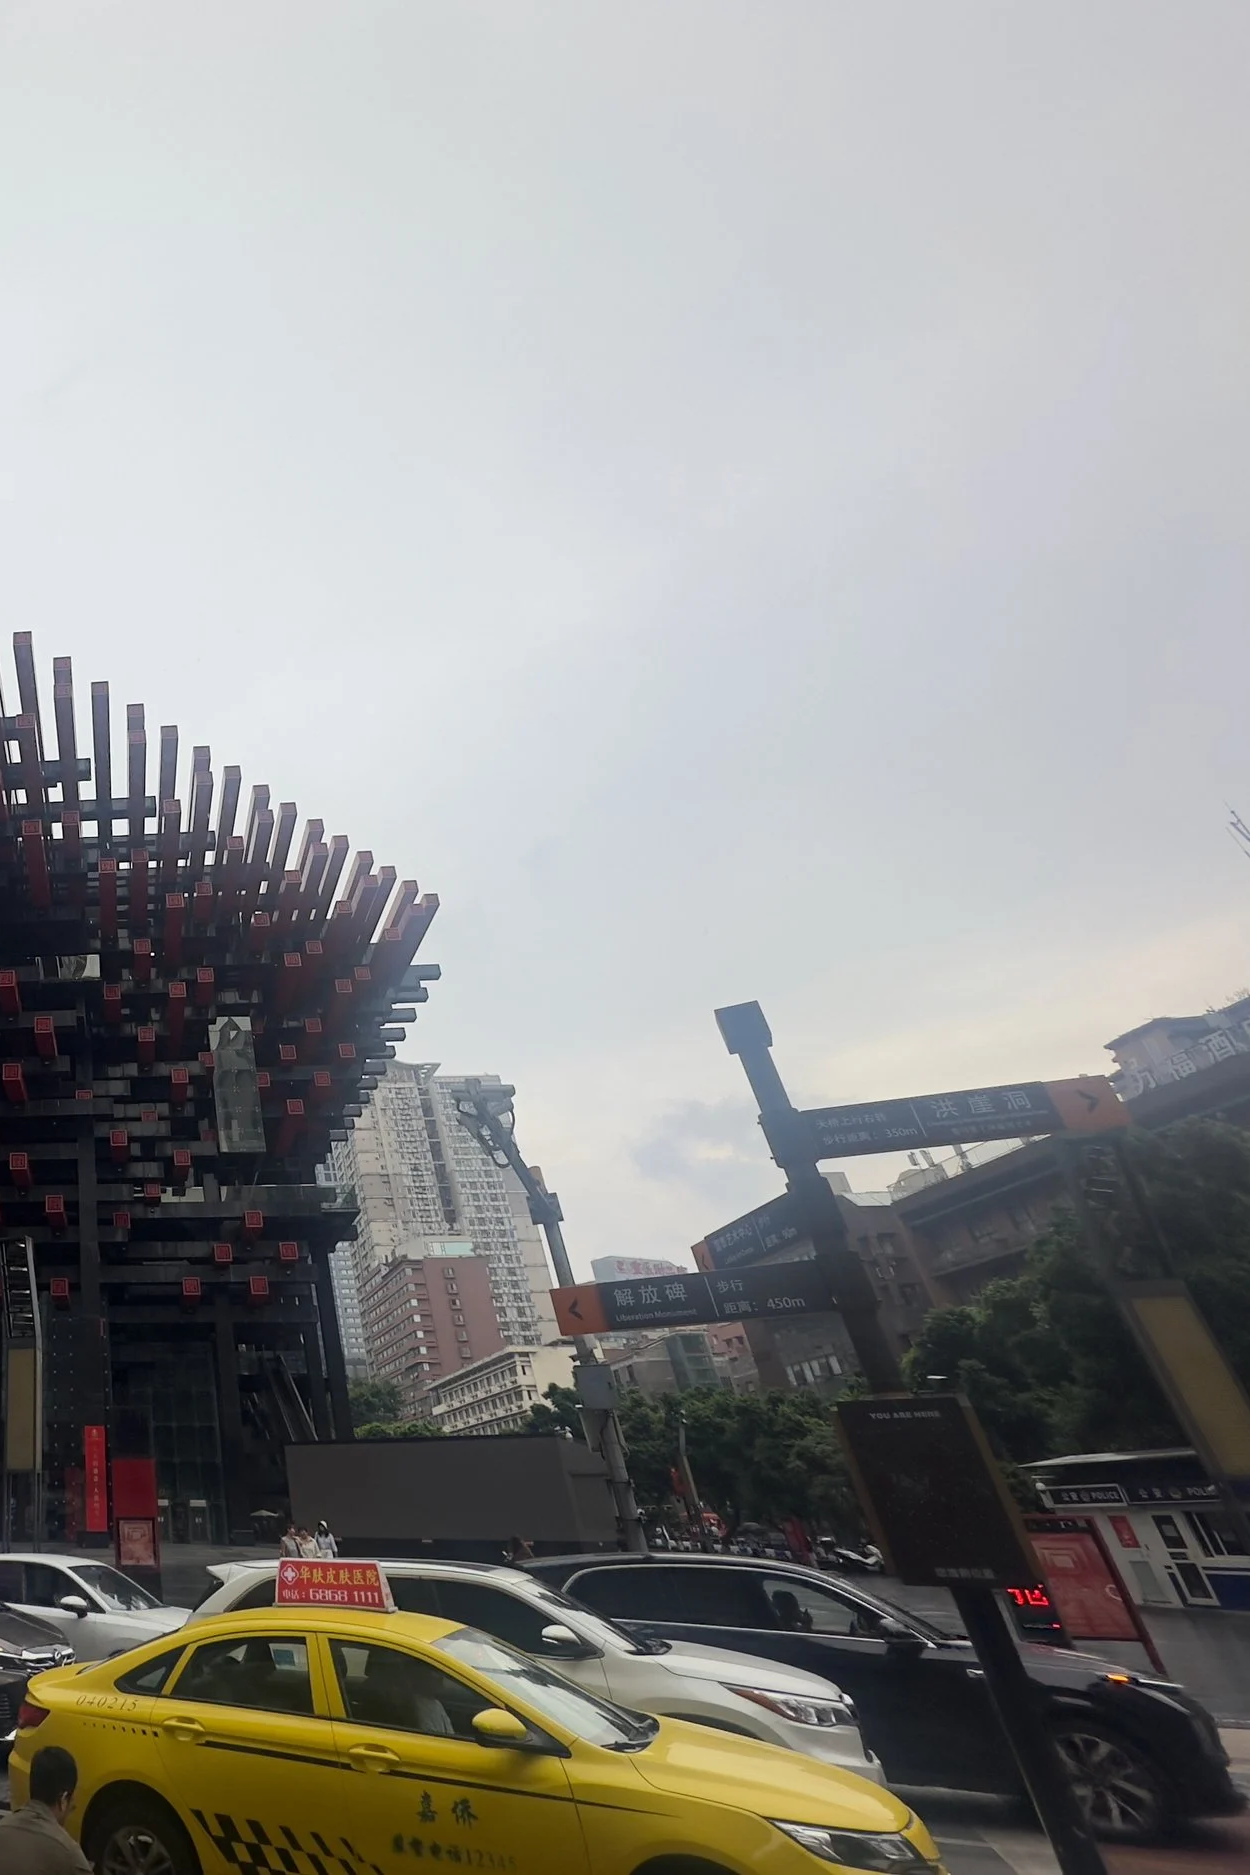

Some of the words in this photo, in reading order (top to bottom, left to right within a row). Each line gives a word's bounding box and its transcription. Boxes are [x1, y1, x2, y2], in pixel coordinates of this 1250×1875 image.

[930, 1090, 1032, 1118] 洪崖洞
[613, 1281, 689, 1307] 解放碑
[716, 1279, 744, 1294] 步行
[615, 1311, 655, 1323] Liberation
[655, 1308, 698, 1319] Monument
[868, 1412, 891, 1420] YOU
[892, 1411, 913, 1419] ARE
[914, 1410, 942, 1419] HERE
[1090, 1490, 1120, 1501] POLICE
[299, 1565, 380, 1587] 华肤皮肤医院
[353, 1590, 380, 1604] 1111
[76, 1695, 138, 1712] 040215
